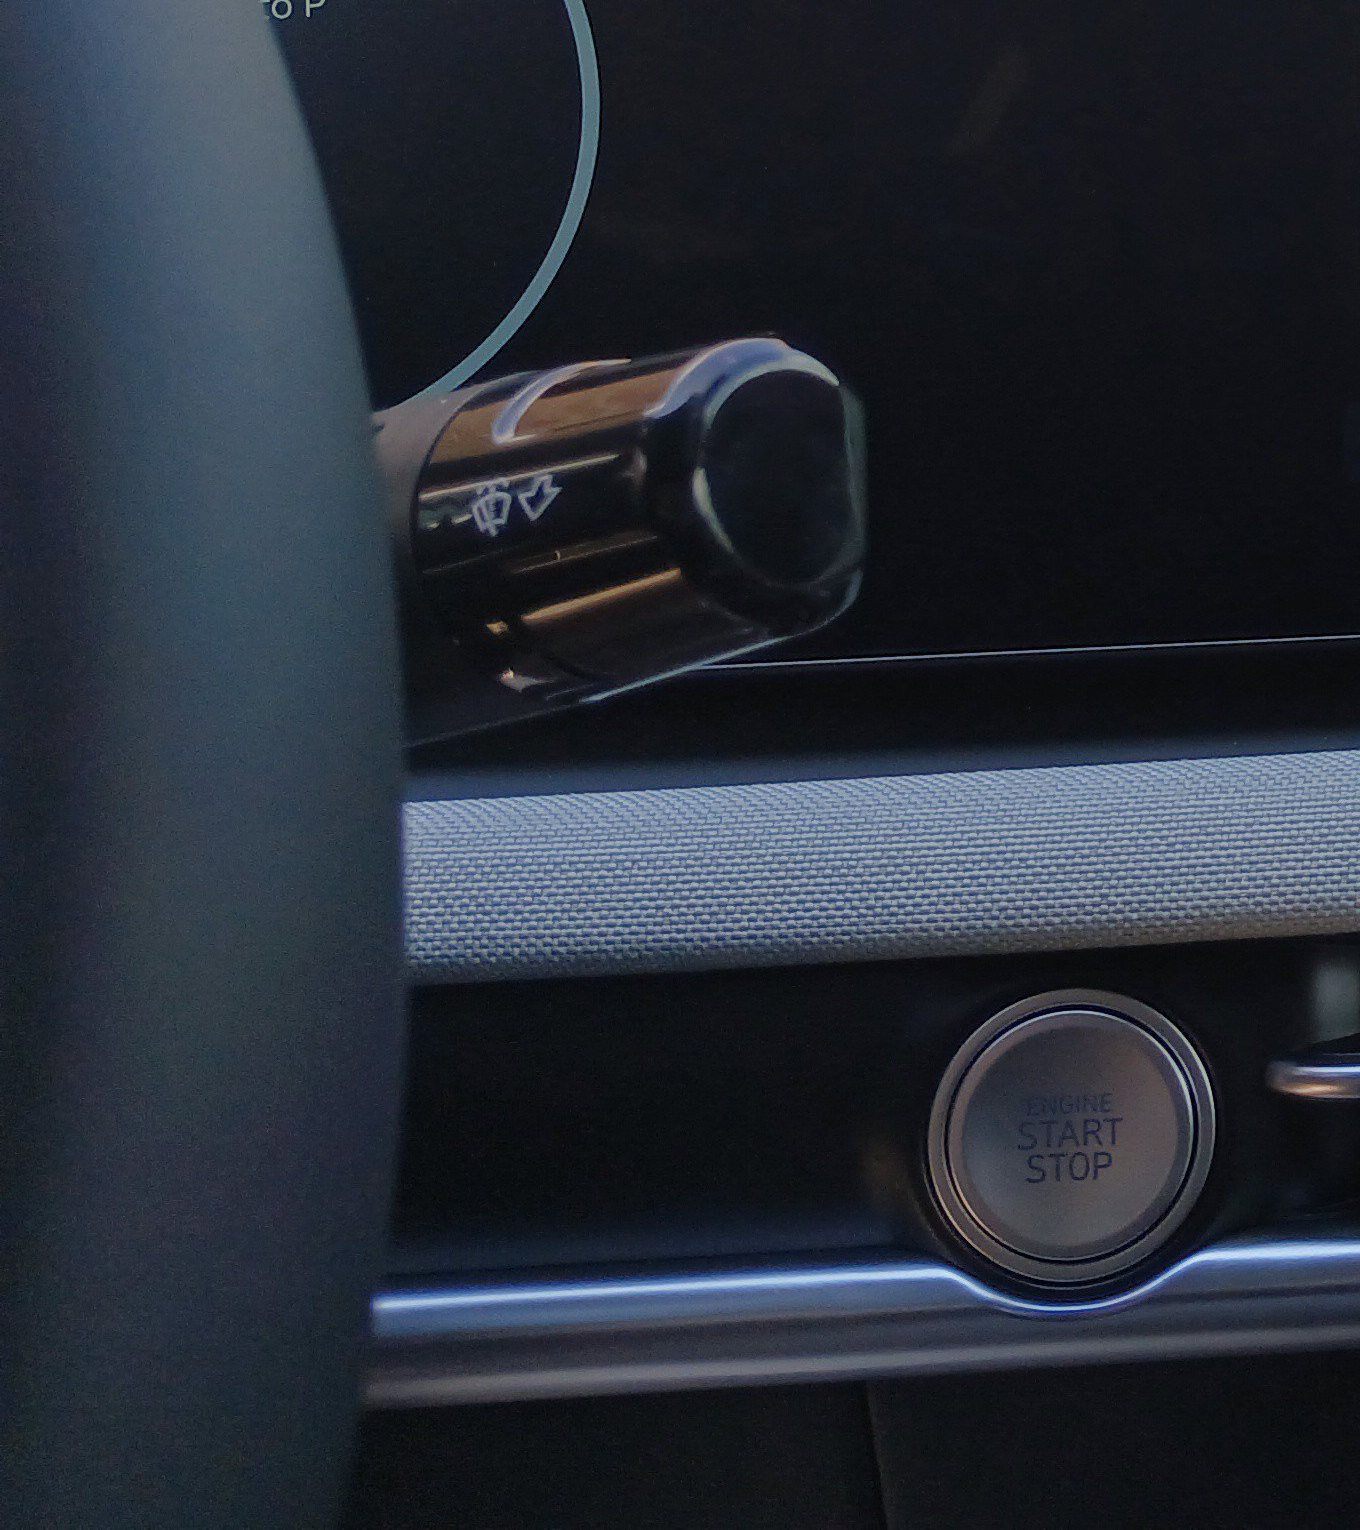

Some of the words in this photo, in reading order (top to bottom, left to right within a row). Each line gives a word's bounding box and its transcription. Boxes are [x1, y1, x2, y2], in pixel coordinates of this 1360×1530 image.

[1026, 1092, 1114, 1116] ENGINE
[1017, 1117, 1124, 1151] START
[1025, 1151, 1113, 1184] STOP
